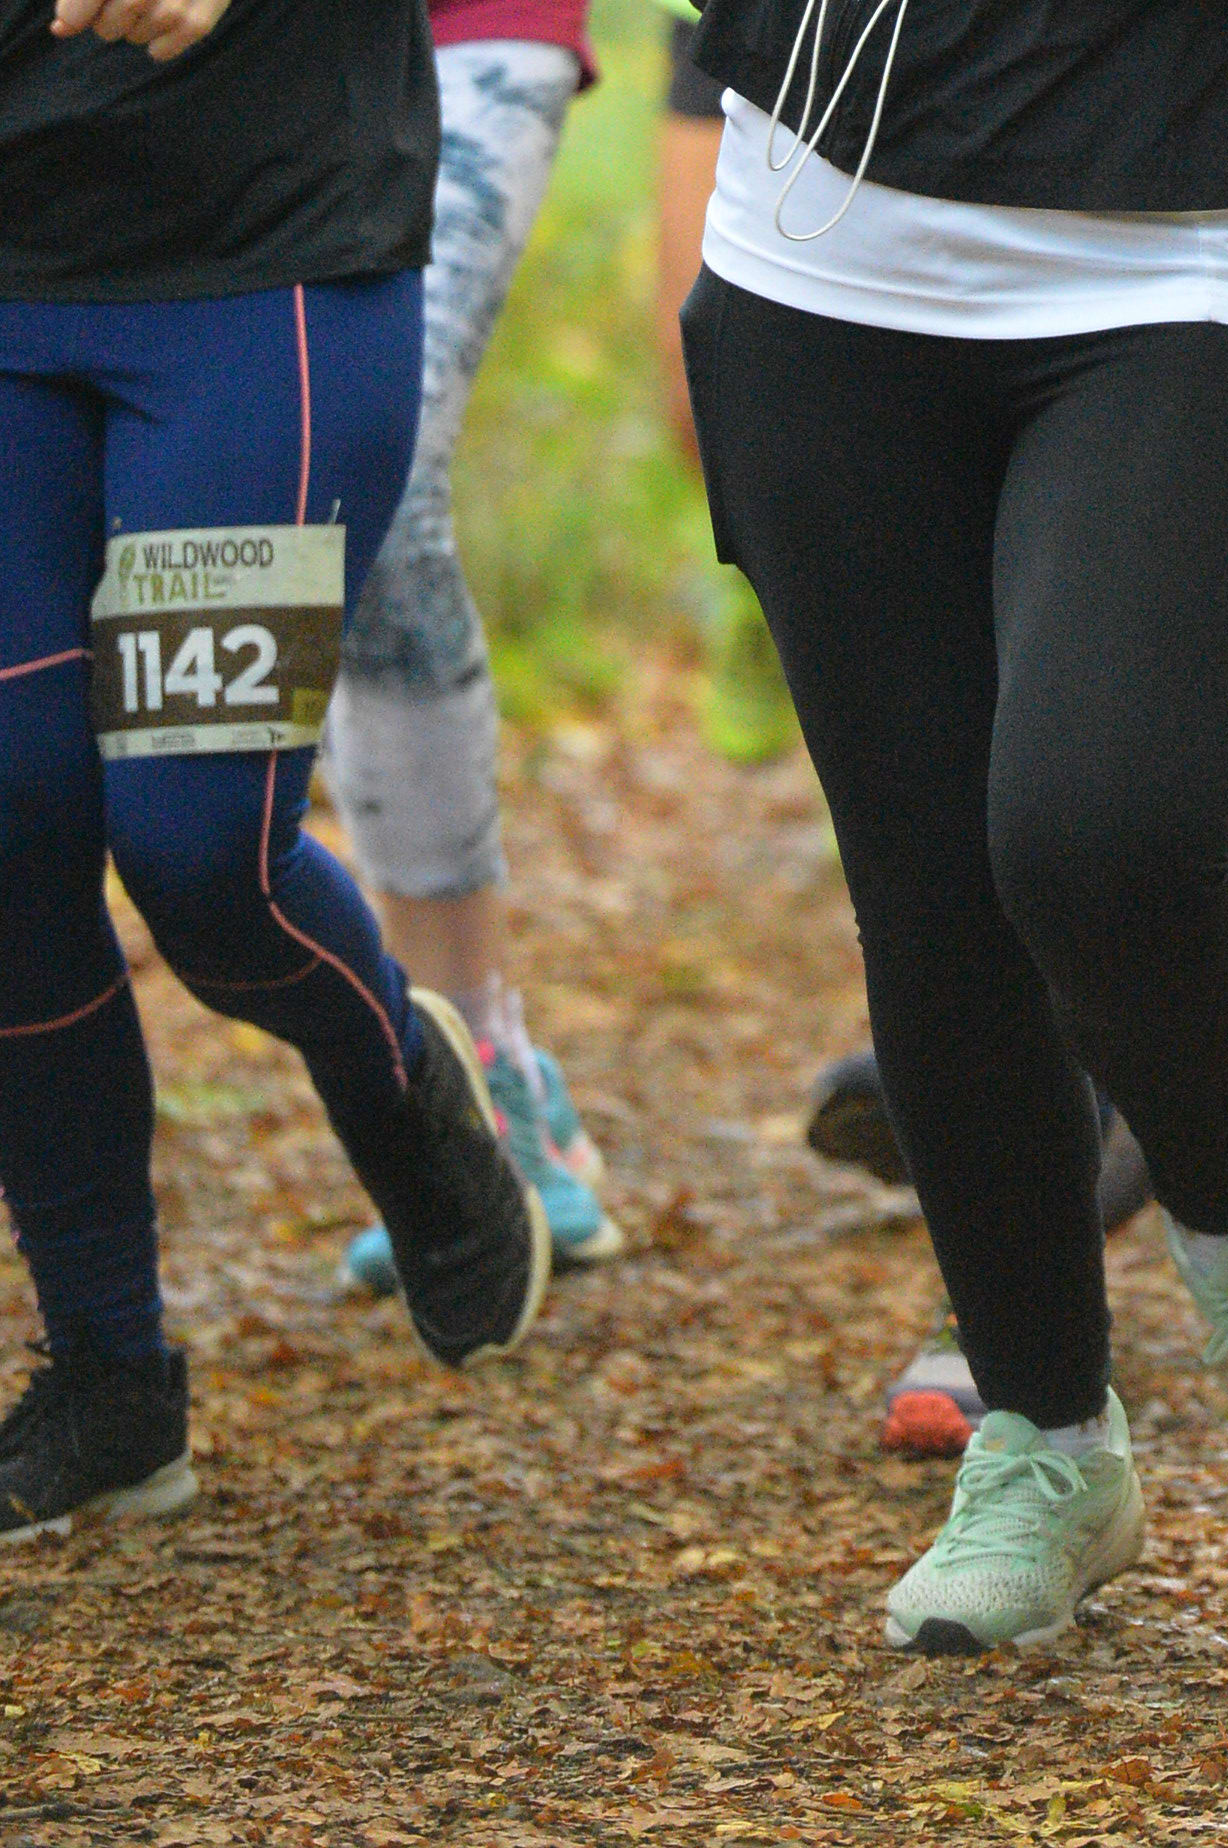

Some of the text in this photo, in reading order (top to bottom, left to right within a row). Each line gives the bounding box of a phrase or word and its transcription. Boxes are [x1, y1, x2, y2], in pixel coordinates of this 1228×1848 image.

[142, 538, 274, 569] WILDWOOD
[132, 572, 226, 605] TRAIL
[117, 624, 280, 713] 1142
